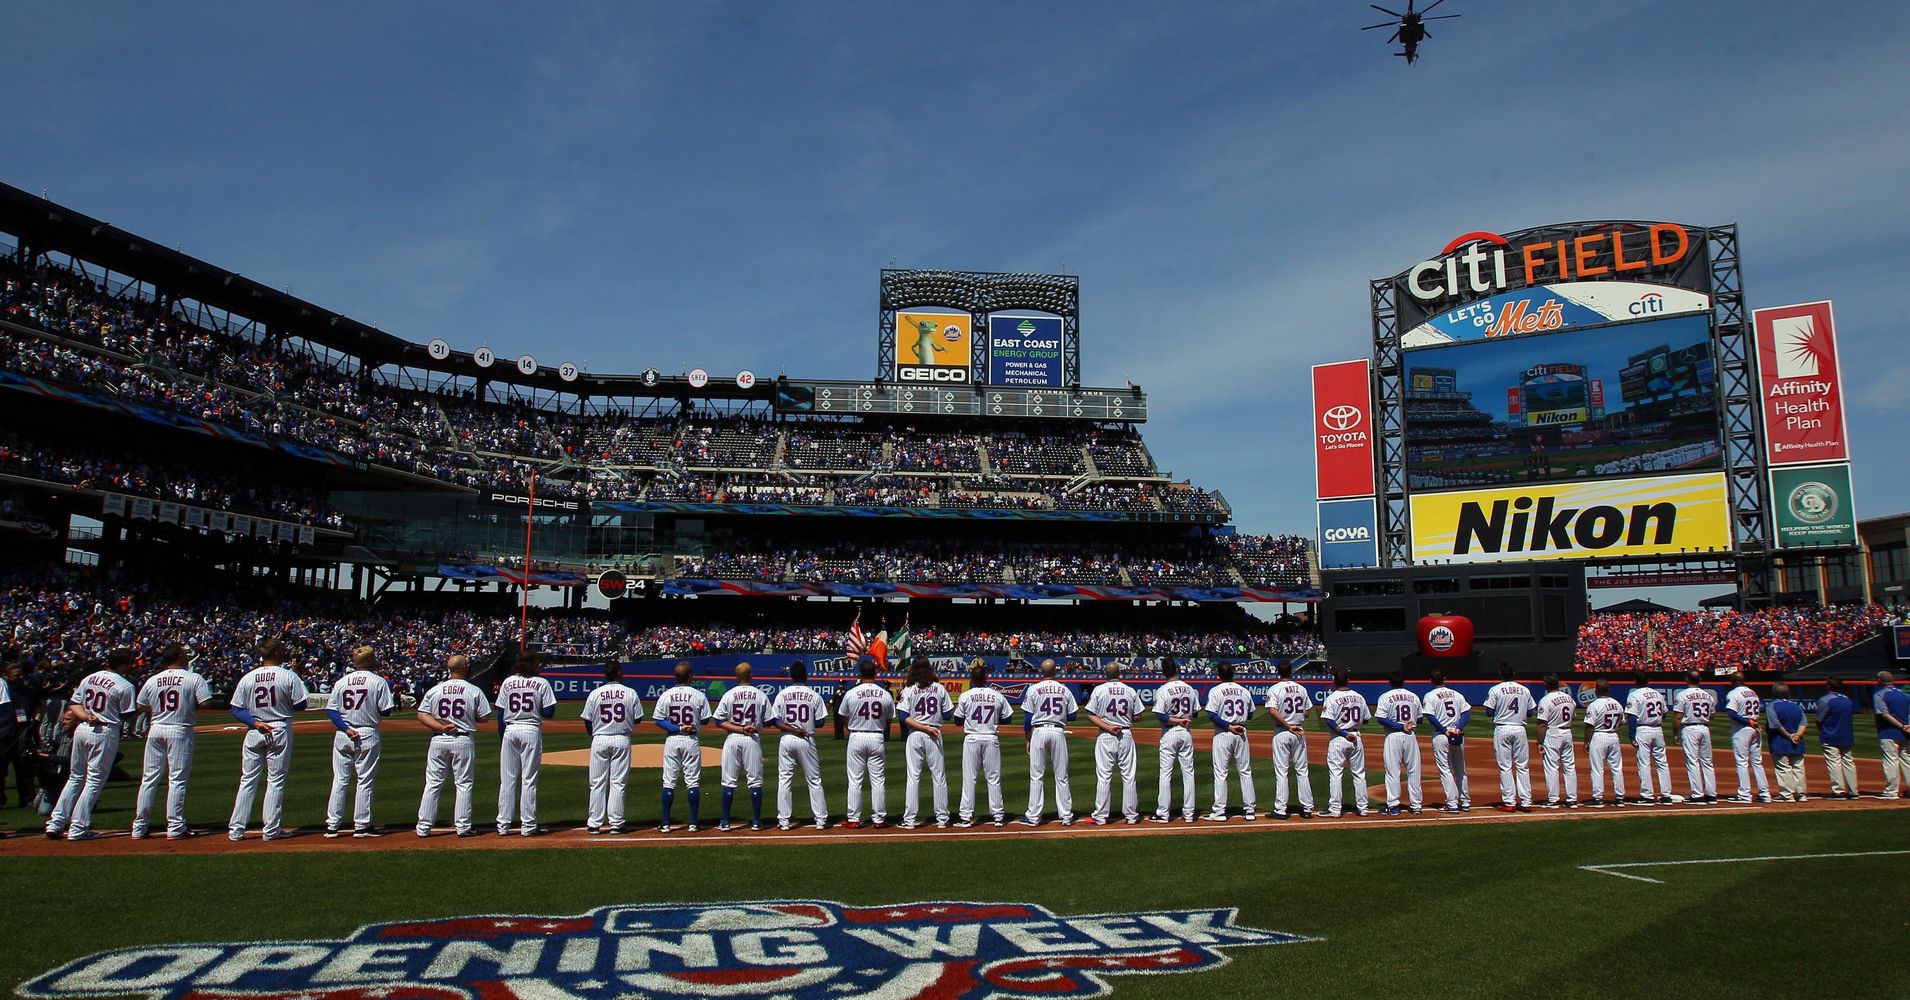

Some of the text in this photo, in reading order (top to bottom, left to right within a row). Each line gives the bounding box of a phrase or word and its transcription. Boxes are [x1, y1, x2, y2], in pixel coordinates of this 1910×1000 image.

[1408, 223, 1689, 300] citi FIELD
[1448, 300, 1492, 324] LET'S
[1628, 296, 1663, 316] citi
[1473, 312, 1494, 328] GO
[1485, 298, 1564, 338] Mets
[434, 344, 445, 354] 31
[994, 338, 1059, 349] EAST COAST
[479, 352, 490, 362] 41
[522, 360, 532, 370] 14
[563, 367, 574, 376] 37
[740, 375, 752, 384] 42
[900, 368, 966, 382] GEICO
[1770, 380, 1831, 398] Affinity
[1775, 399, 1829, 416] Health
[1535, 410, 1578, 424] Nikon
[1786, 416, 1820, 431] Plan
[1320, 432, 1367, 444] TOYOTA
[1782, 442, 1804, 451] Affinity
[492, 494, 578, 510] PORSCHE
[1325, 527, 1369, 541] GOYA
[1453, 496, 1677, 556] Nikon
[626, 580, 645, 589] 24
[158, 676, 184, 688] BRUCE
[255, 672, 275, 683] DUDA
[348, 676, 366, 686] LUGO
[443, 686, 465, 695] EDGIN
[554, 681, 603, 692] DELT
[857, 690, 883, 699] SMOKER
[1037, 687, 1065, 695] WHEELER
[1109, 687, 1125, 695] REED
[1222, 688, 1243, 697] HARVEY
[1285, 685, 1299, 694] MATZ
[1501, 687, 1524, 695] FLORES
[85, 688, 107, 713] 20
[158, 689, 180, 712] 19
[255, 685, 276, 708] 21
[342, 689, 368, 710] 67
[509, 692, 534, 713] 65
[600, 691, 624, 700] SALAS
[670, 694, 692, 702] KELLY
[734, 691, 756, 700] RIVERA
[971, 694, 995, 703] ROBLES
[1436, 692, 1455, 700] WRIGHT
[439, 698, 465, 719] 66
[600, 703, 626, 723] 59
[786, 704, 810, 723] 50
[858, 701, 882, 720] 49
[915, 696, 938, 715] 48
[1040, 697, 1063, 716] 45
[1106, 698, 1128, 717] 43
[1171, 697, 1191, 714] 39
[1224, 700, 1245, 716] 33
[1284, 697, 1304, 714] 32
[1395, 705, 1411, 721] 18
[1444, 701, 1455, 718] 5
[1508, 697, 1519, 714] 4
[1646, 701, 1662, 718] 23
[1693, 703, 1709, 717] 53
[1746, 701, 1759, 716] 22
[669, 706, 694, 725] 56
[732, 704, 756, 724] 54
[972, 705, 996, 724] 47
[1341, 706, 1361, 723] 30
[1562, 706, 1570, 722] 6
[1603, 713, 1620, 729] 57
[50, 909, 1276, 989] OPENING WEEK
